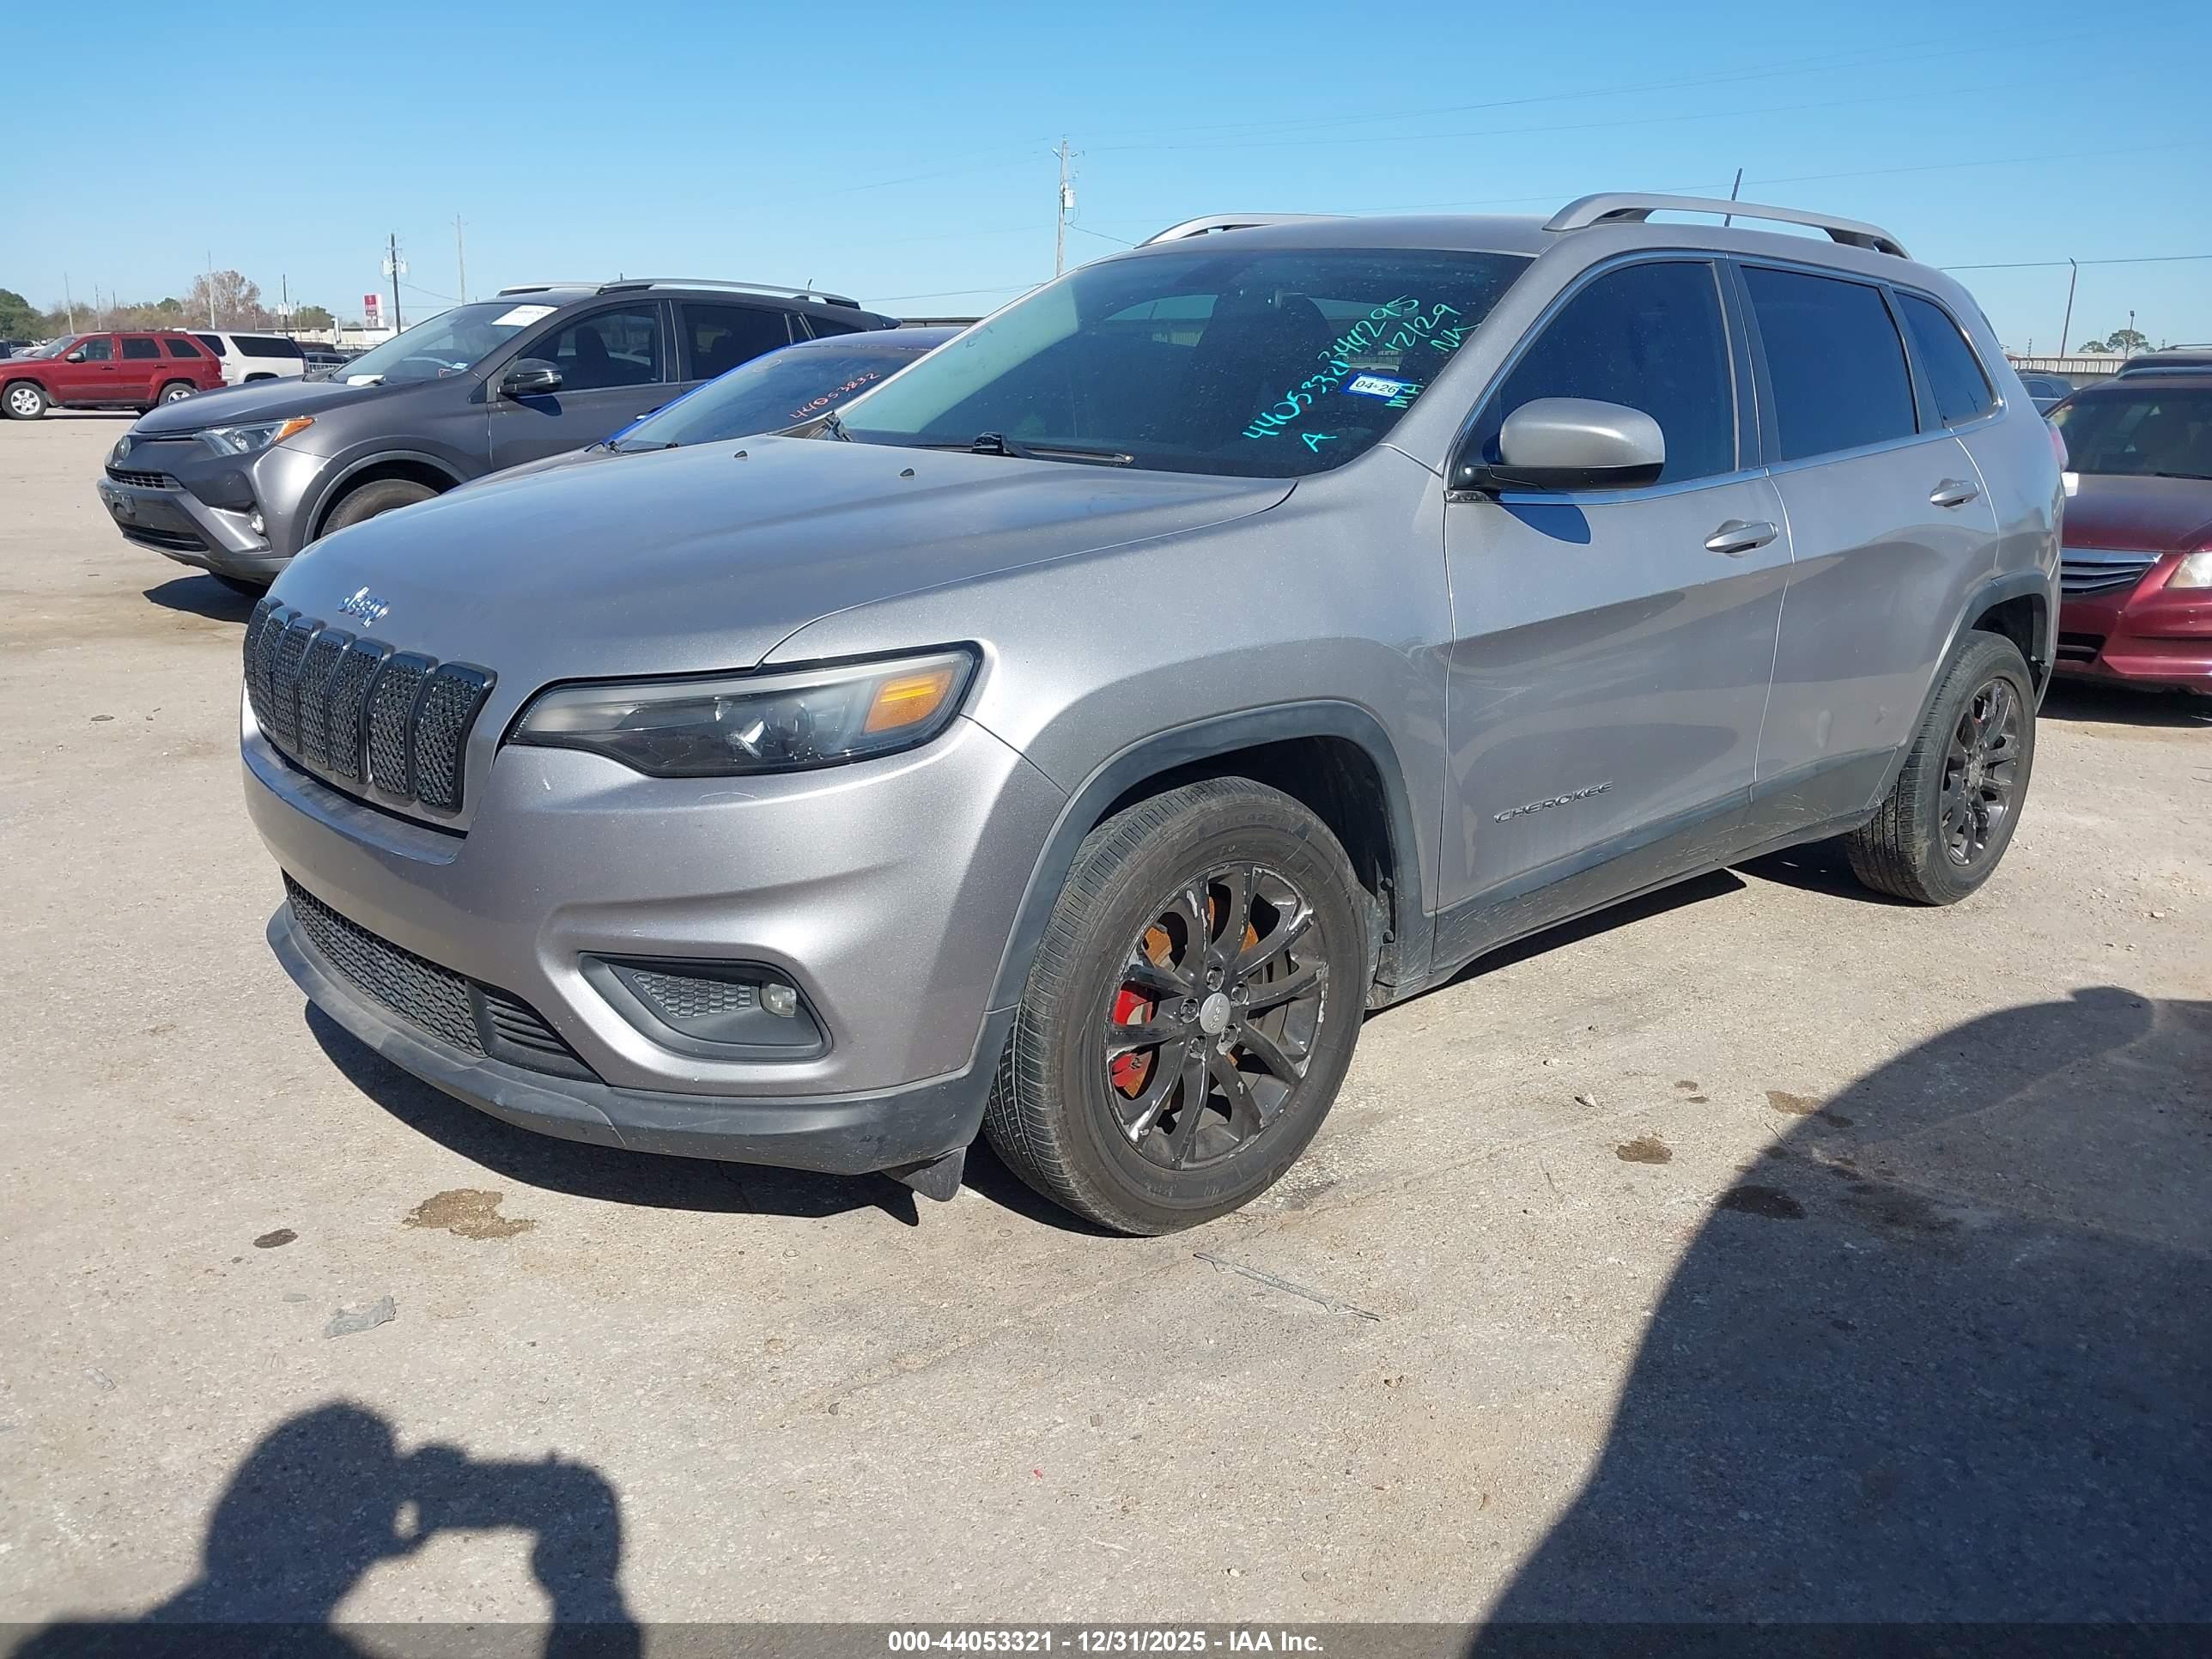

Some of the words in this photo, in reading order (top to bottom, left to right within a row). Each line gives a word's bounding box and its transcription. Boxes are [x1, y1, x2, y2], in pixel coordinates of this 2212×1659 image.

[1384, 302, 1462, 351] 12/29
[789, 372, 880, 419] 44053832
[1301, 431, 1339, 453] A
[1493, 781, 1614, 823] CHEROKEE
